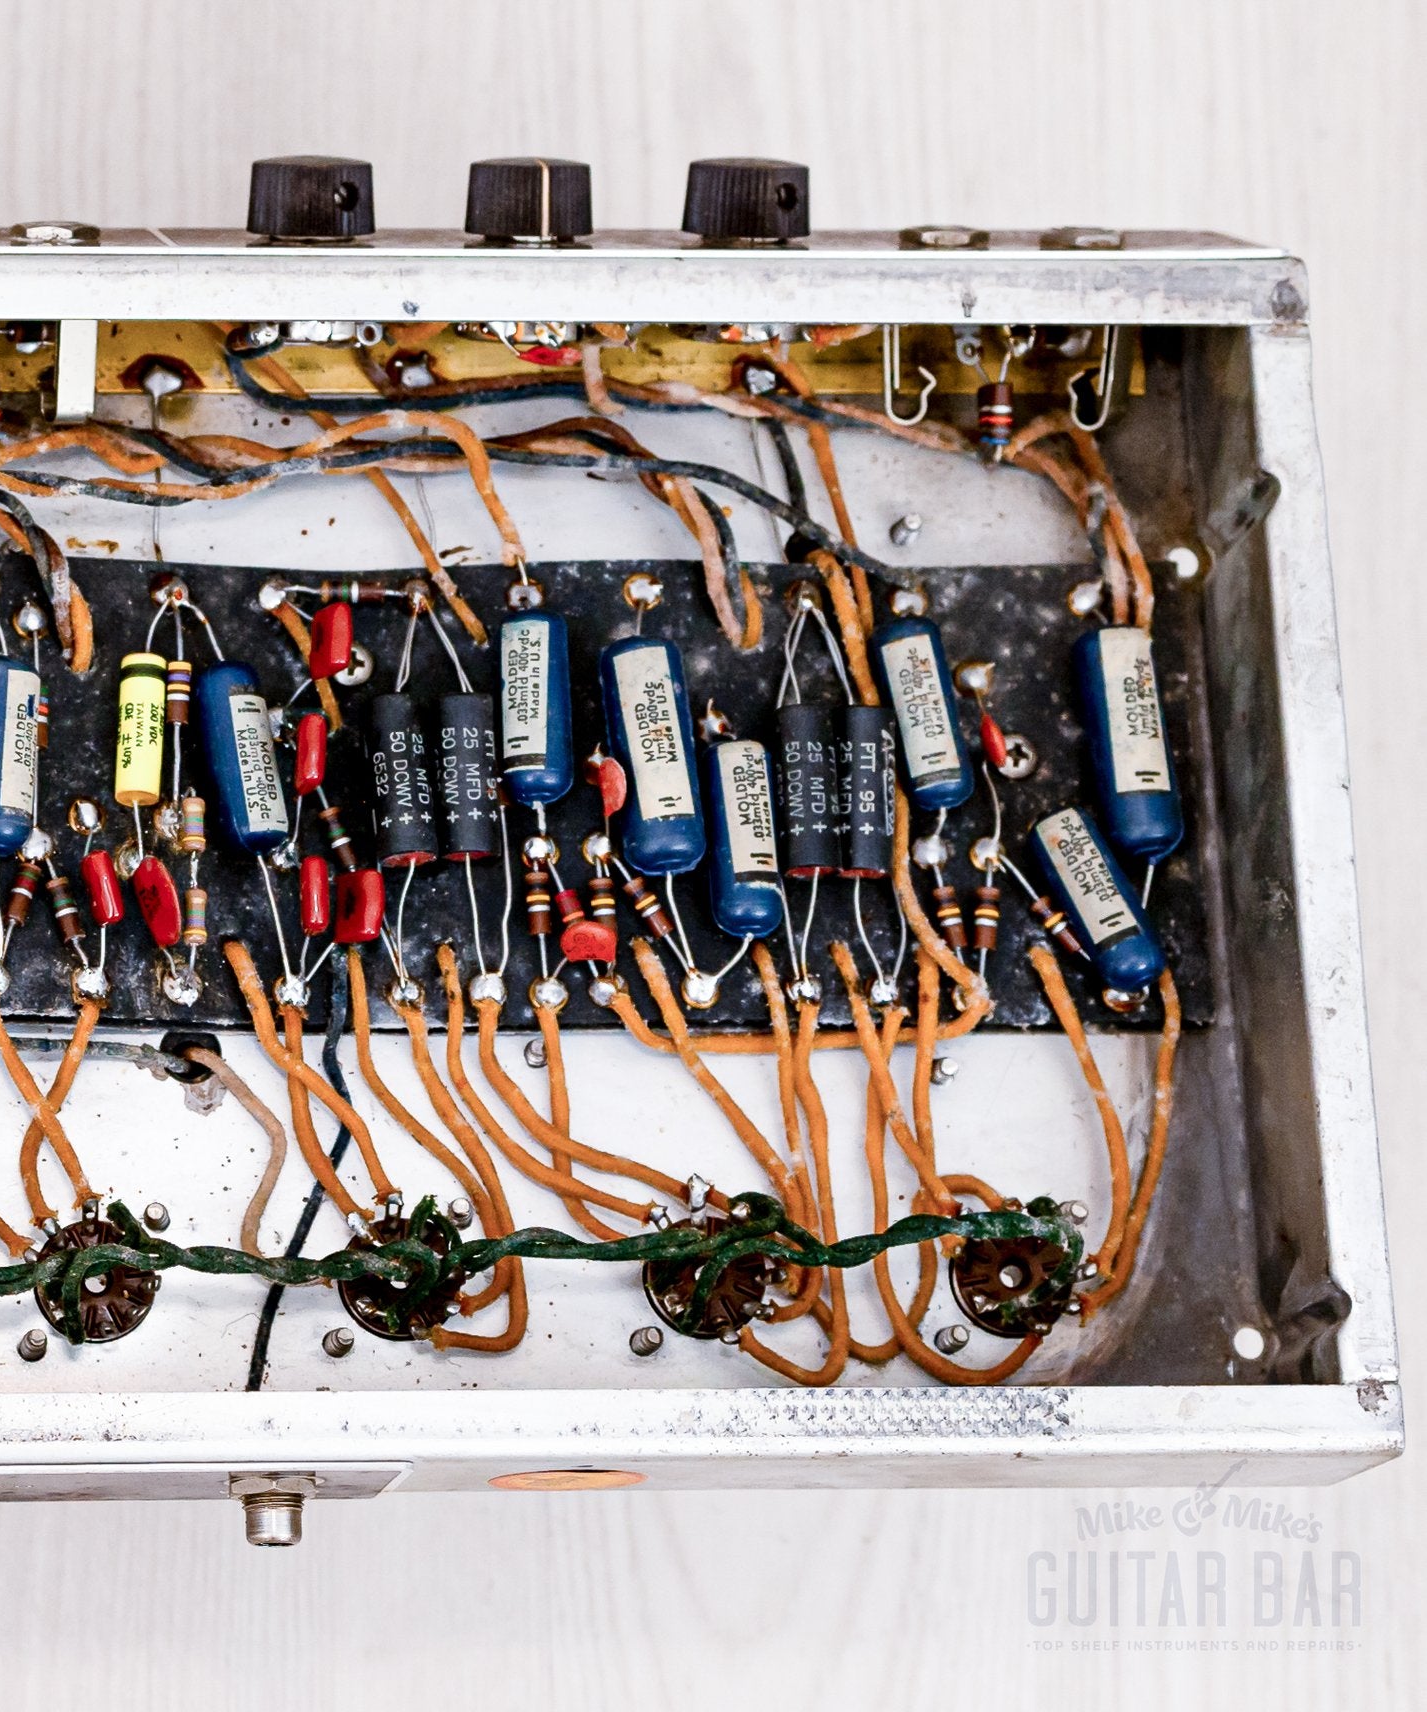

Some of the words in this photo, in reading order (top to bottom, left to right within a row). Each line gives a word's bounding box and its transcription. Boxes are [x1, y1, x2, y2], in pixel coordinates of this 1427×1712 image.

[516, 629, 530, 671] 400vdc
[508, 650, 521, 710] MOLDED
[517, 676, 528, 724] .033mfd
[530, 683, 540, 718] Made
[899, 669, 921, 728] MOLDED
[125, 703, 134, 720] CDE
[150, 703, 159, 722] 200
[643, 682, 660, 724] 400vdc
[1123, 677, 1138, 735] MOLDED
[14, 704, 28, 763] MOLDED
[136, 703, 144, 747] TAIWAN
[149, 726, 157, 744] VDC
[390, 731, 406, 752] 50
[412, 733, 424, 755] 25
[442, 727, 456, 749] 50
[463, 727, 478, 749] 25
[635, 703, 655, 762] MOLDED
[664, 726, 678, 762] Made
[247, 723, 263, 771] .033mfd
[785, 741, 801, 763] 50
[807, 741, 823, 762] 25
[860, 743, 876, 772] PTT
[237, 730, 250, 765] Made
[246, 786, 259, 812] U.S.
[259, 741, 277, 800] MOLDED
[373, 752, 389, 796] 6532
[393, 760, 412, 806] DCWV
[416, 768, 430, 804] MFD
[443, 756, 459, 804] DCWV
[466, 763, 481, 800] MFD
[733, 766, 751, 825] MOLDED
[788, 769, 804, 817] DCWV
[810, 777, 826, 814] MFD
[859, 790, 875, 813] 95
[749, 793, 765, 842] .033mfd
[1057, 839, 1093, 895] MOLDED
